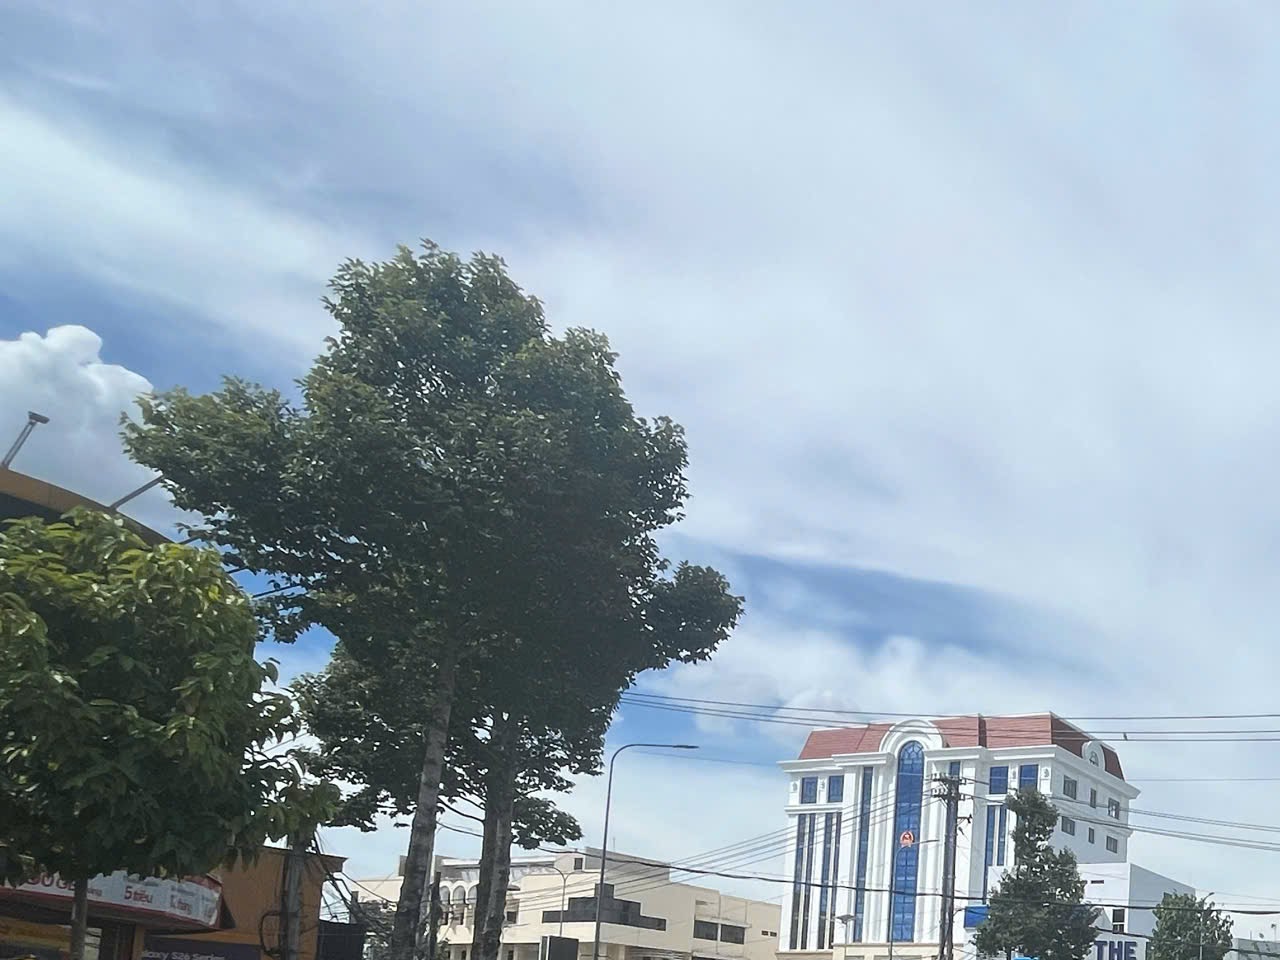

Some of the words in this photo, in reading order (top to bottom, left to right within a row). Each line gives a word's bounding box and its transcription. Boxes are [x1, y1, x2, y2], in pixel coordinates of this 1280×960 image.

[124, 886, 132, 899] 5
[141, 950, 169, 960] laxy
[172, 952, 191, 960] S26
